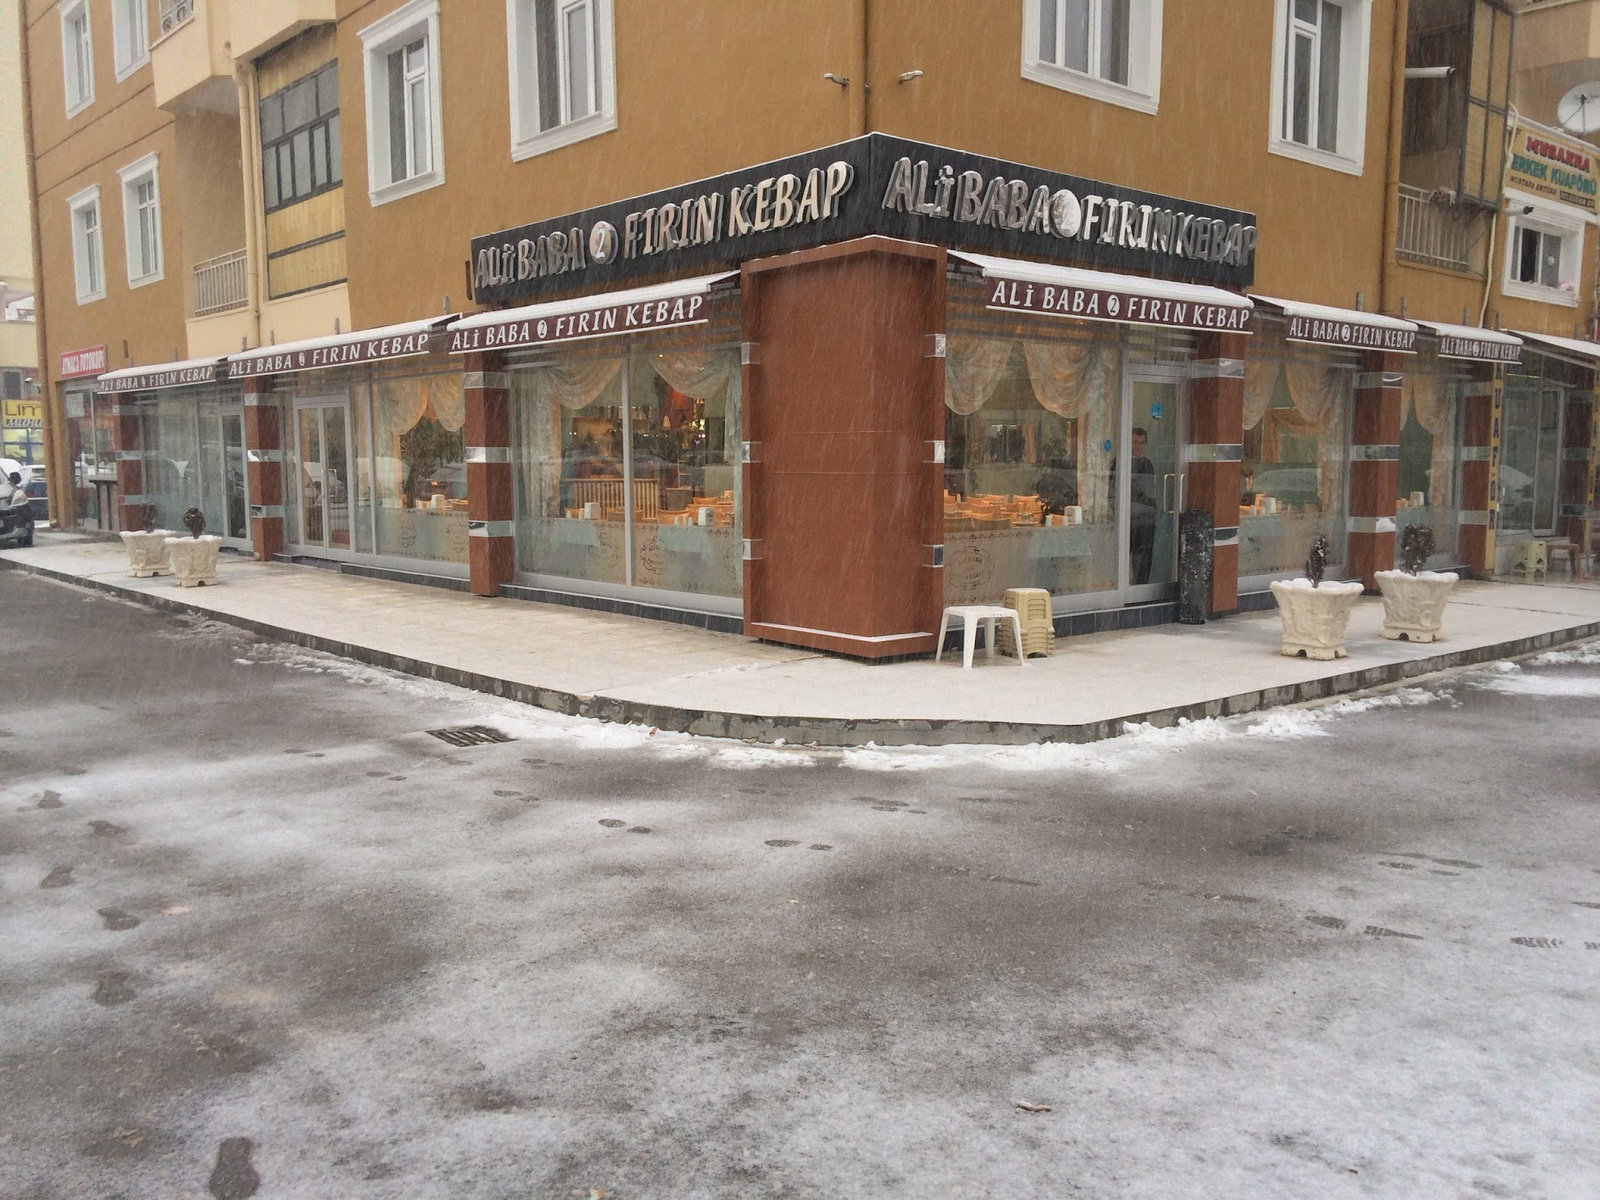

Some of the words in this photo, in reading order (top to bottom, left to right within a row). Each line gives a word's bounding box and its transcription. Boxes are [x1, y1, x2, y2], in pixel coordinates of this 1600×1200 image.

[517, 227, 587, 281] BABA
[624, 192, 724, 259] FIRIN
[728, 161, 854, 238] KEBAP
[954, 170, 1051, 236] BABA
[1080, 194, 1172, 255] FIRIN
[1171, 211, 1258, 266] KEBAP
[485, 322, 530, 346] BABA
[536, 321, 548, 339] 2
[556, 308, 617, 337] FIRIN
[625, 295, 703, 326] KEBAP
[1042, 287, 1100, 315] BABA
[1107, 294, 1120, 316] 2
[1127, 297, 1187, 324] FIRIN
[1192, 305, 1250, 329] KEBAP
[256, 354, 292, 372] BABA
[312, 343, 361, 365] FIRIN
[367, 333, 429, 357] KEBAP
[1312, 321, 1339, 340] BABA
[1352, 326, 1381, 344] FIRIN
[1384, 329, 1415, 349] KEBAP
[1455, 339, 1472, 356] BABA
[1480, 342, 1499, 358] FIRIN
[1500, 343, 1521, 360] KEBAP
[116, 377, 138, 389] BABA
[150, 371, 176, 386] FIRIN
[180, 366, 213, 382] KEBAP
